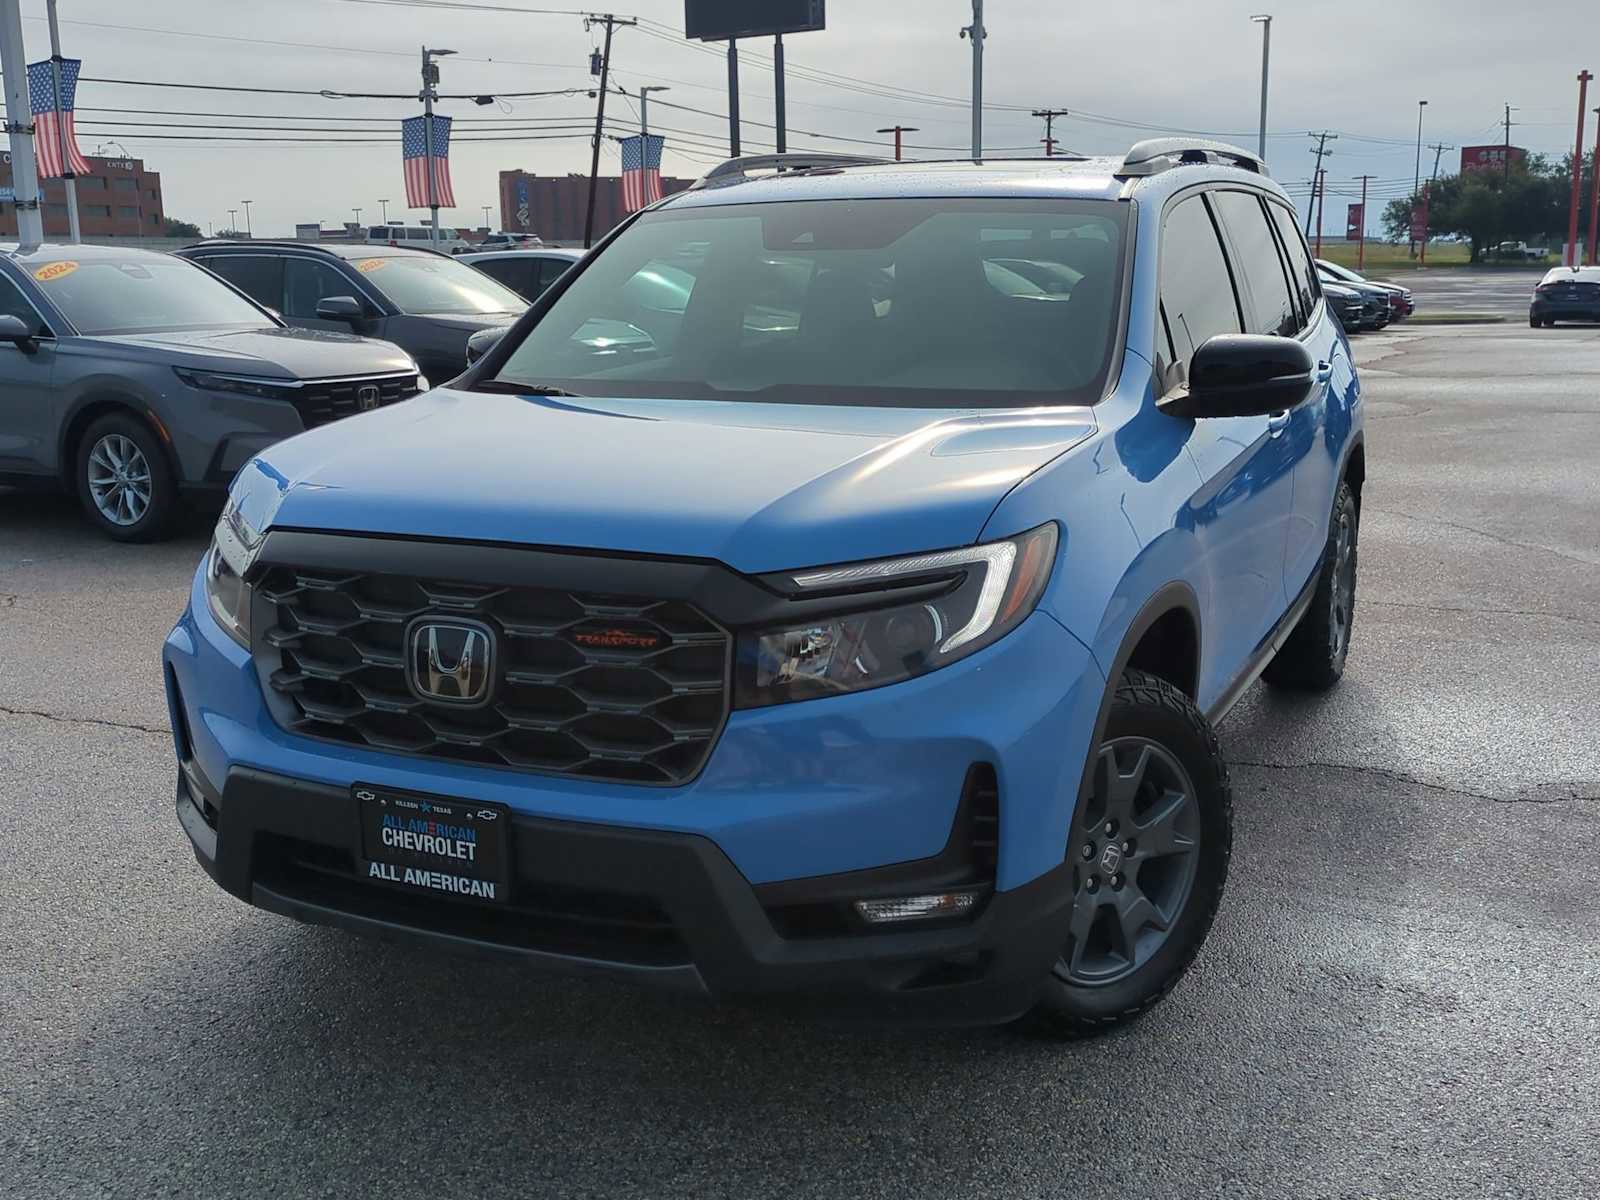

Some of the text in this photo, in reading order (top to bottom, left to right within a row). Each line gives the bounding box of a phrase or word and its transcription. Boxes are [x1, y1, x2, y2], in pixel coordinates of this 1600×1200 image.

[433, 806, 452, 815] TEXAS
[382, 814, 476, 841] ALL AMERICAN
[382, 827, 476, 861] CHEVROLET
[369, 861, 496, 899] ALL AMERICAN
